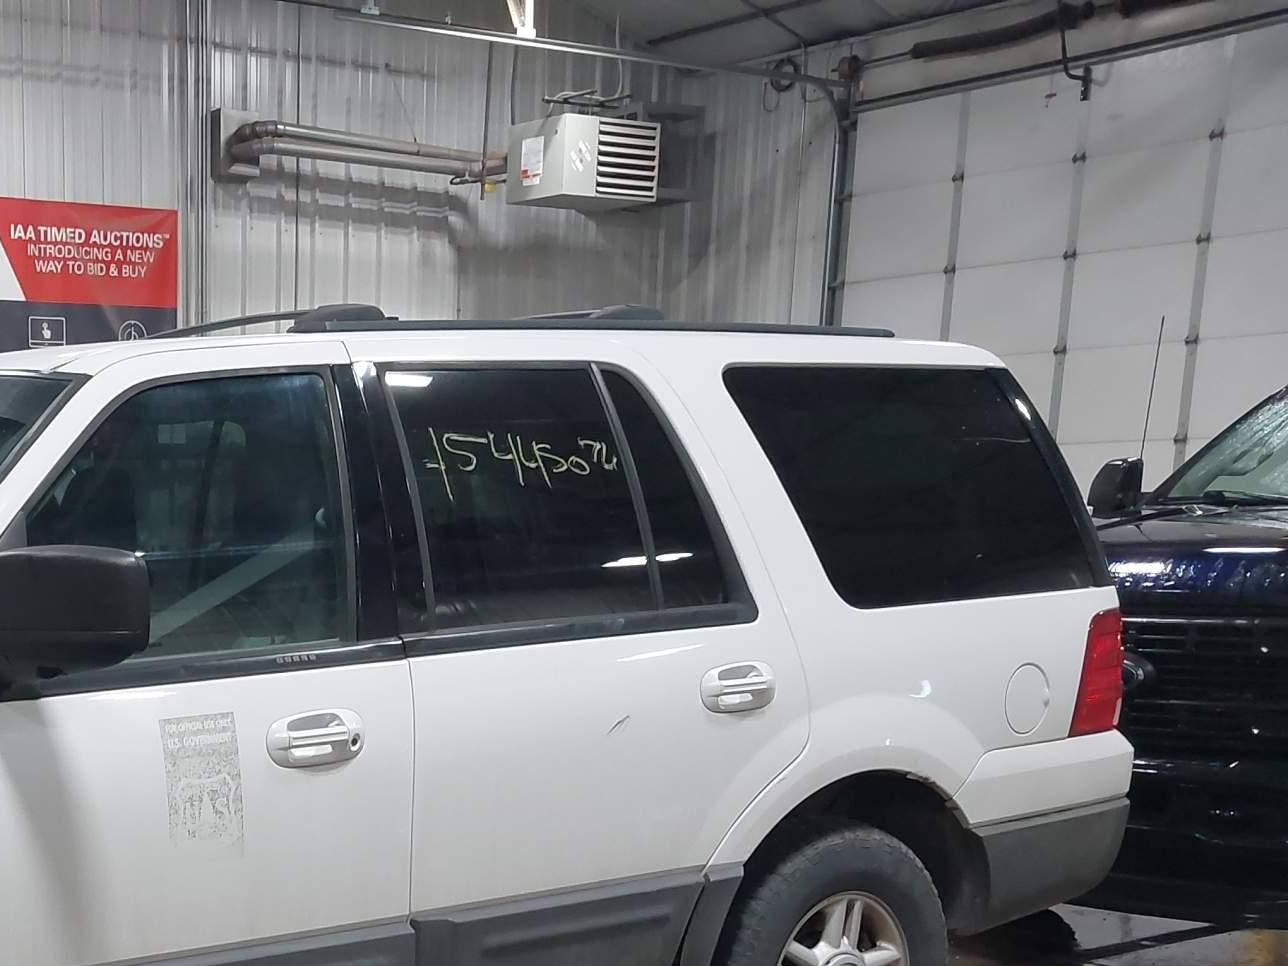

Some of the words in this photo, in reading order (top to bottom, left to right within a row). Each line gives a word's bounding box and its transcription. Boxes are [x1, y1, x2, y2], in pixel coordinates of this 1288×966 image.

[10, 224, 35, 242] IAA
[38, 226, 85, 244] TIMED
[27, 243, 111, 262] INTRODUCING
[114, 249, 124, 261] A
[126, 249, 154, 263] NEW
[35, 260, 63, 274] WAY
[66, 262, 83, 275] TO
[87, 263, 106, 276] BID
[109, 264, 119, 277] &
[122, 265, 147, 278] BUY
